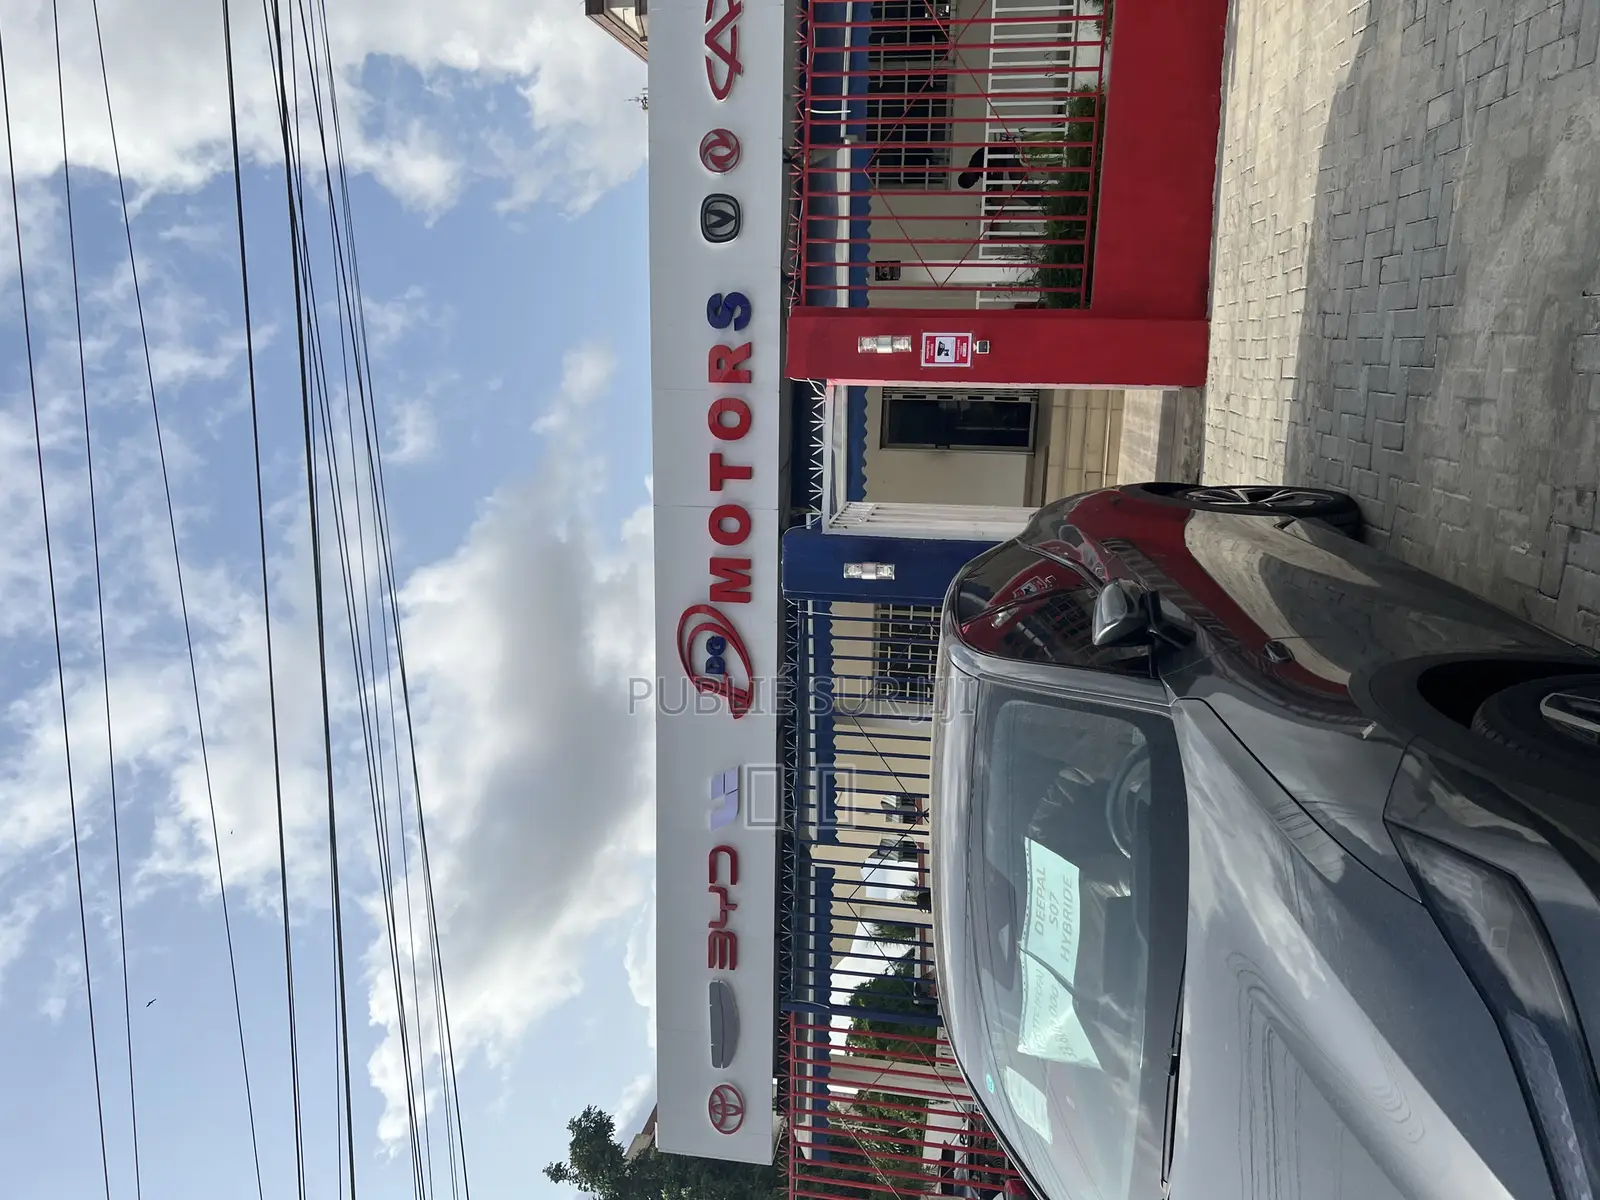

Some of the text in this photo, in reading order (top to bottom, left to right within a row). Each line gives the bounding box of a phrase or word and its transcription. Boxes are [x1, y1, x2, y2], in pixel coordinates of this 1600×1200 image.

[706, 291, 752, 603] MOTORS
[708, 844, 738, 971] BYD
[1035, 866, 1046, 936] DEEPAL
[1049, 891, 1061, 931] S07
[1060, 874, 1073, 963] HYBRIDE
